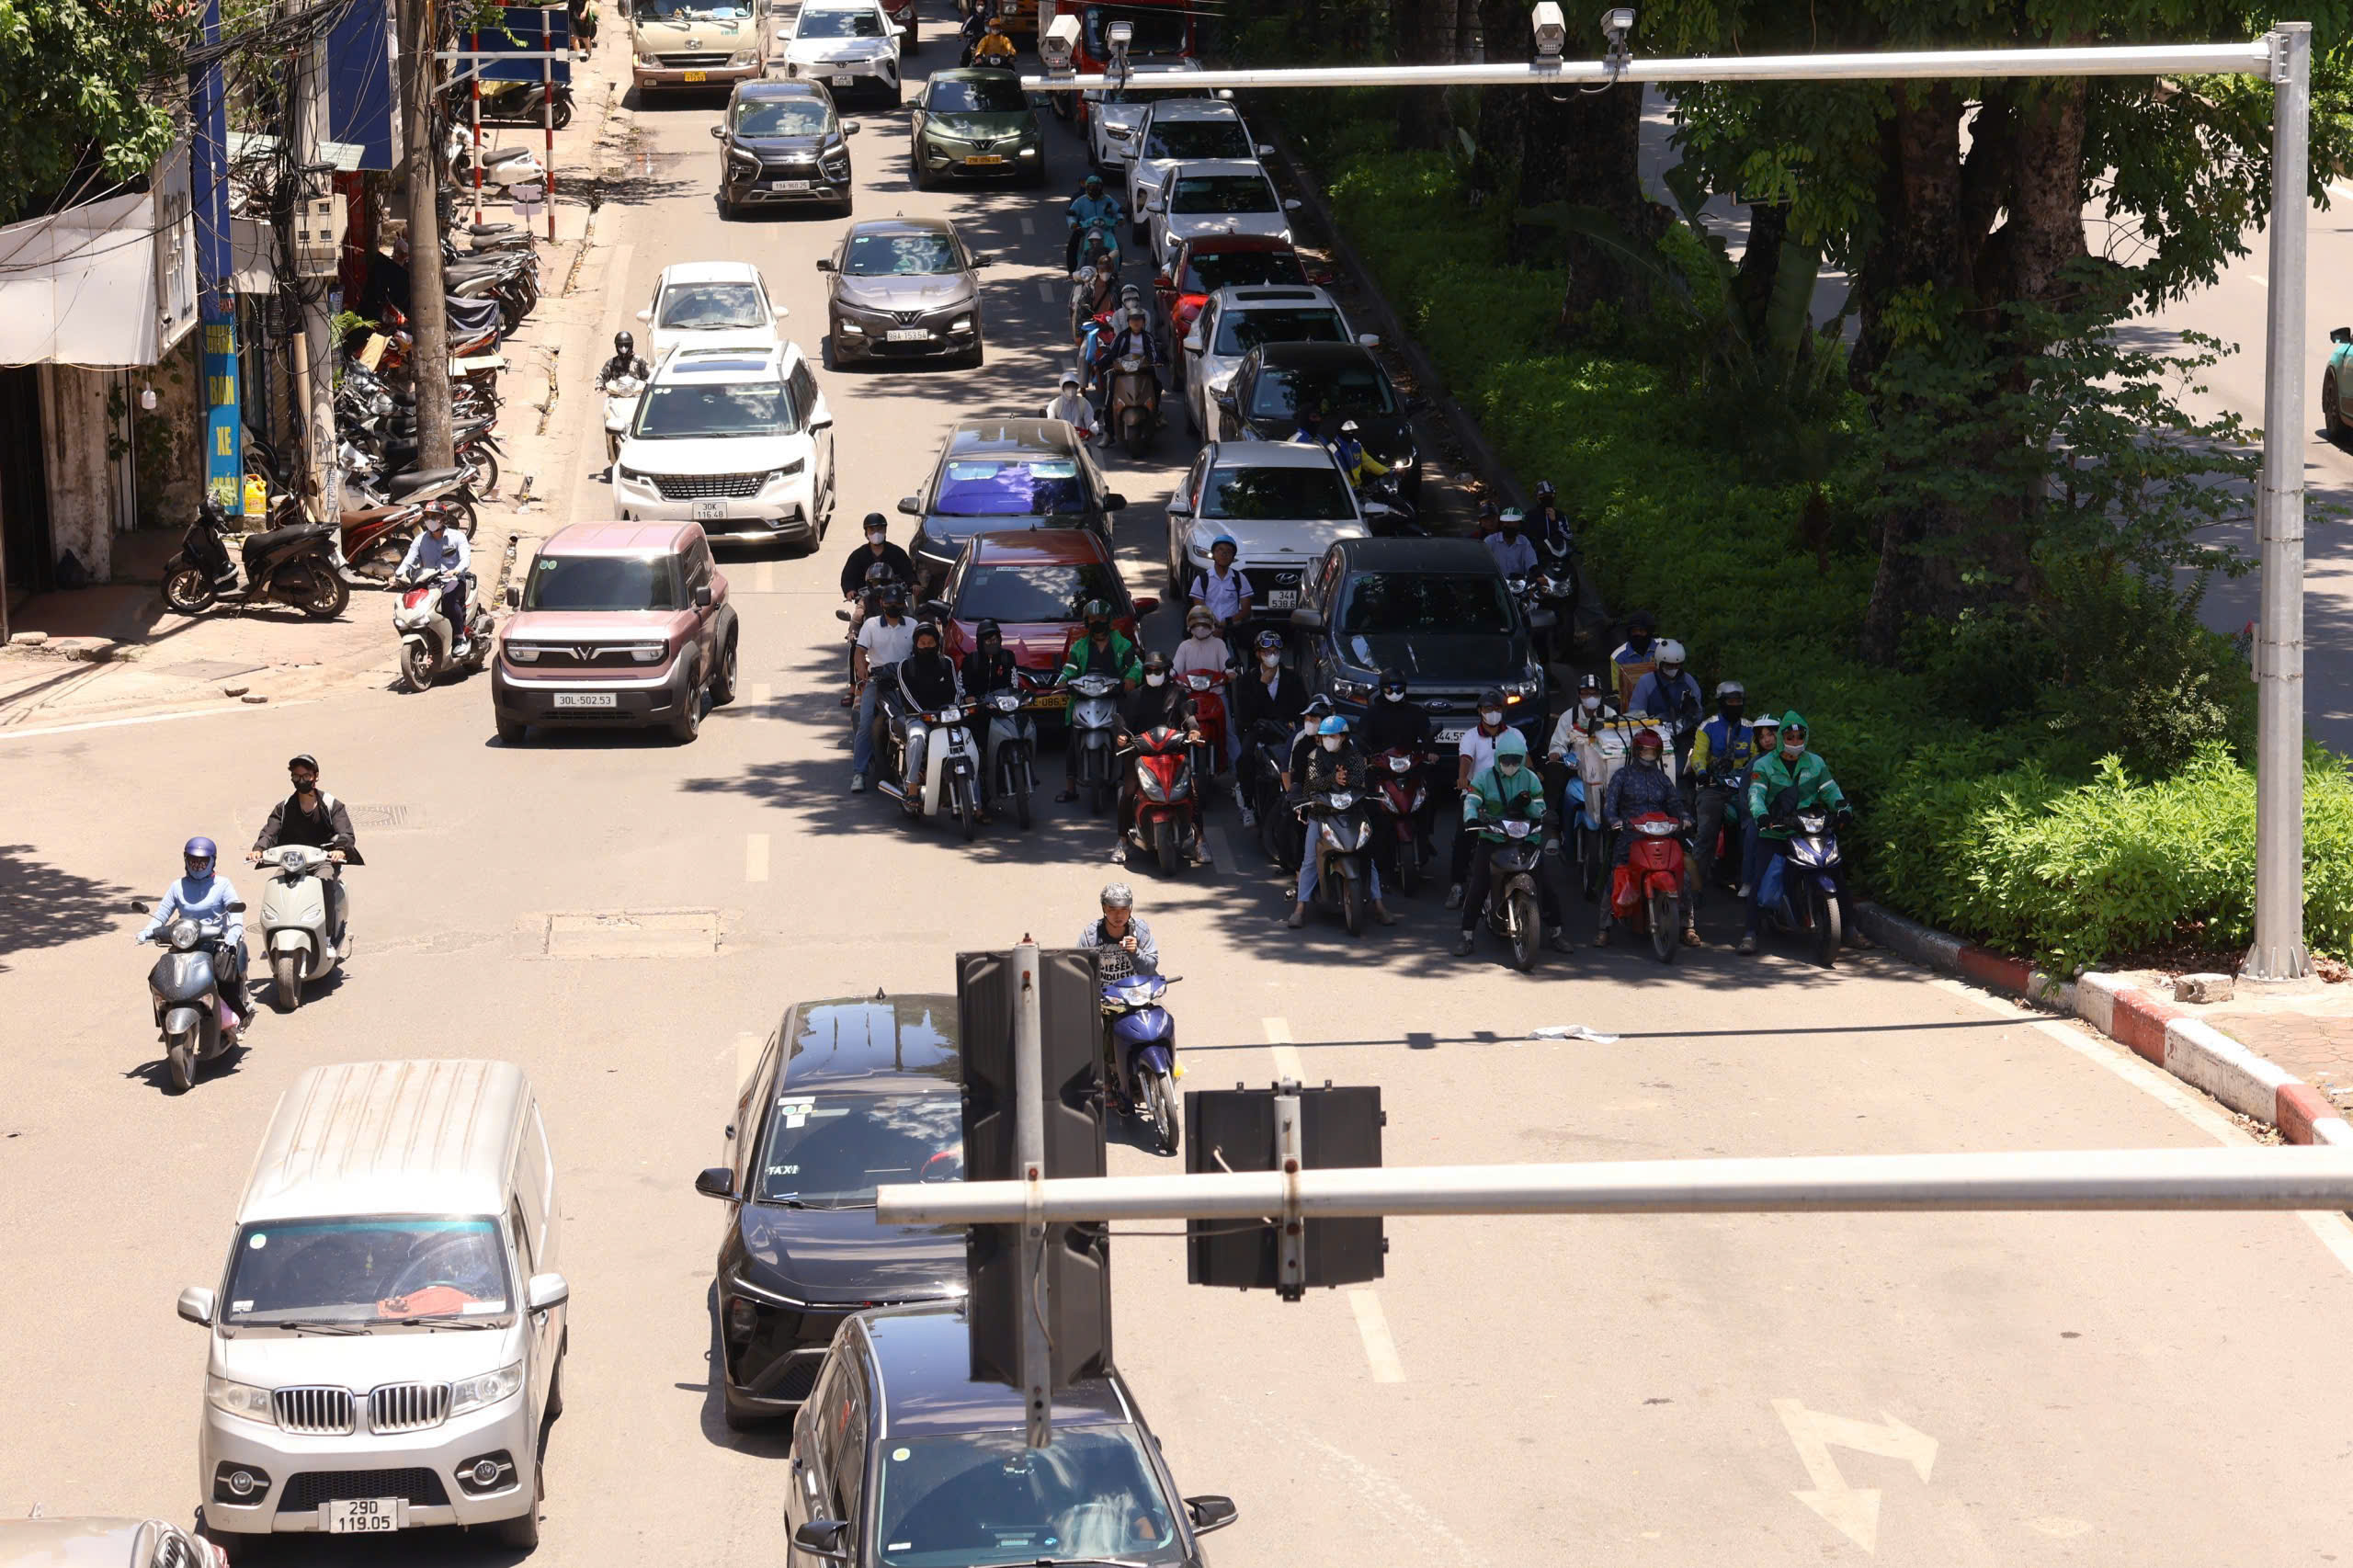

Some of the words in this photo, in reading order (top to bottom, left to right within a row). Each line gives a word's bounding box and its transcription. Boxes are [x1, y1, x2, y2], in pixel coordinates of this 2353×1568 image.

[210, 371, 235, 405] BÁN
[216, 426, 233, 457] XE
[702, 503, 717, 511] 30K
[1279, 591, 1295, 599] 34A
[1271, 599, 1296, 608] 538.6
[768, 1165, 800, 1176] TAXI
[349, 1500, 378, 1516] 29D
[339, 1516, 391, 1531] 119.05
